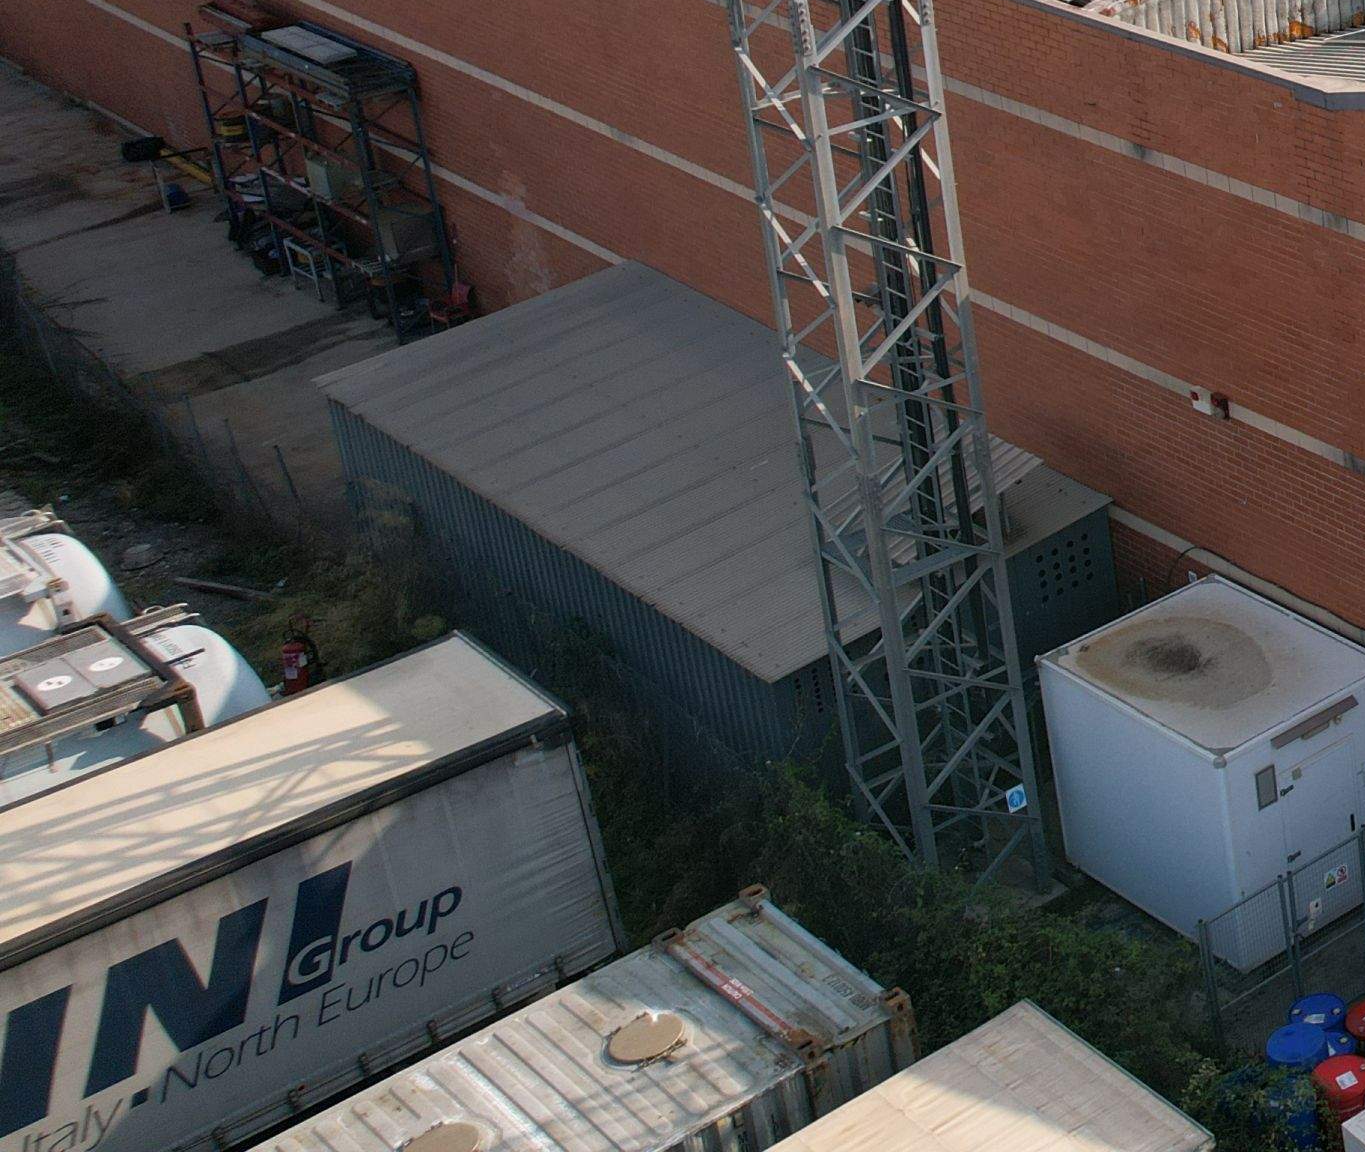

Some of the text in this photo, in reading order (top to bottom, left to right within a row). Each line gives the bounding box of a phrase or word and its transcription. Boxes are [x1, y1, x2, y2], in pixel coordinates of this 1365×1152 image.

[286, 884, 463, 987] Group
[160, 1015, 301, 1104] North
[316, 929, 476, 1028] Europe
